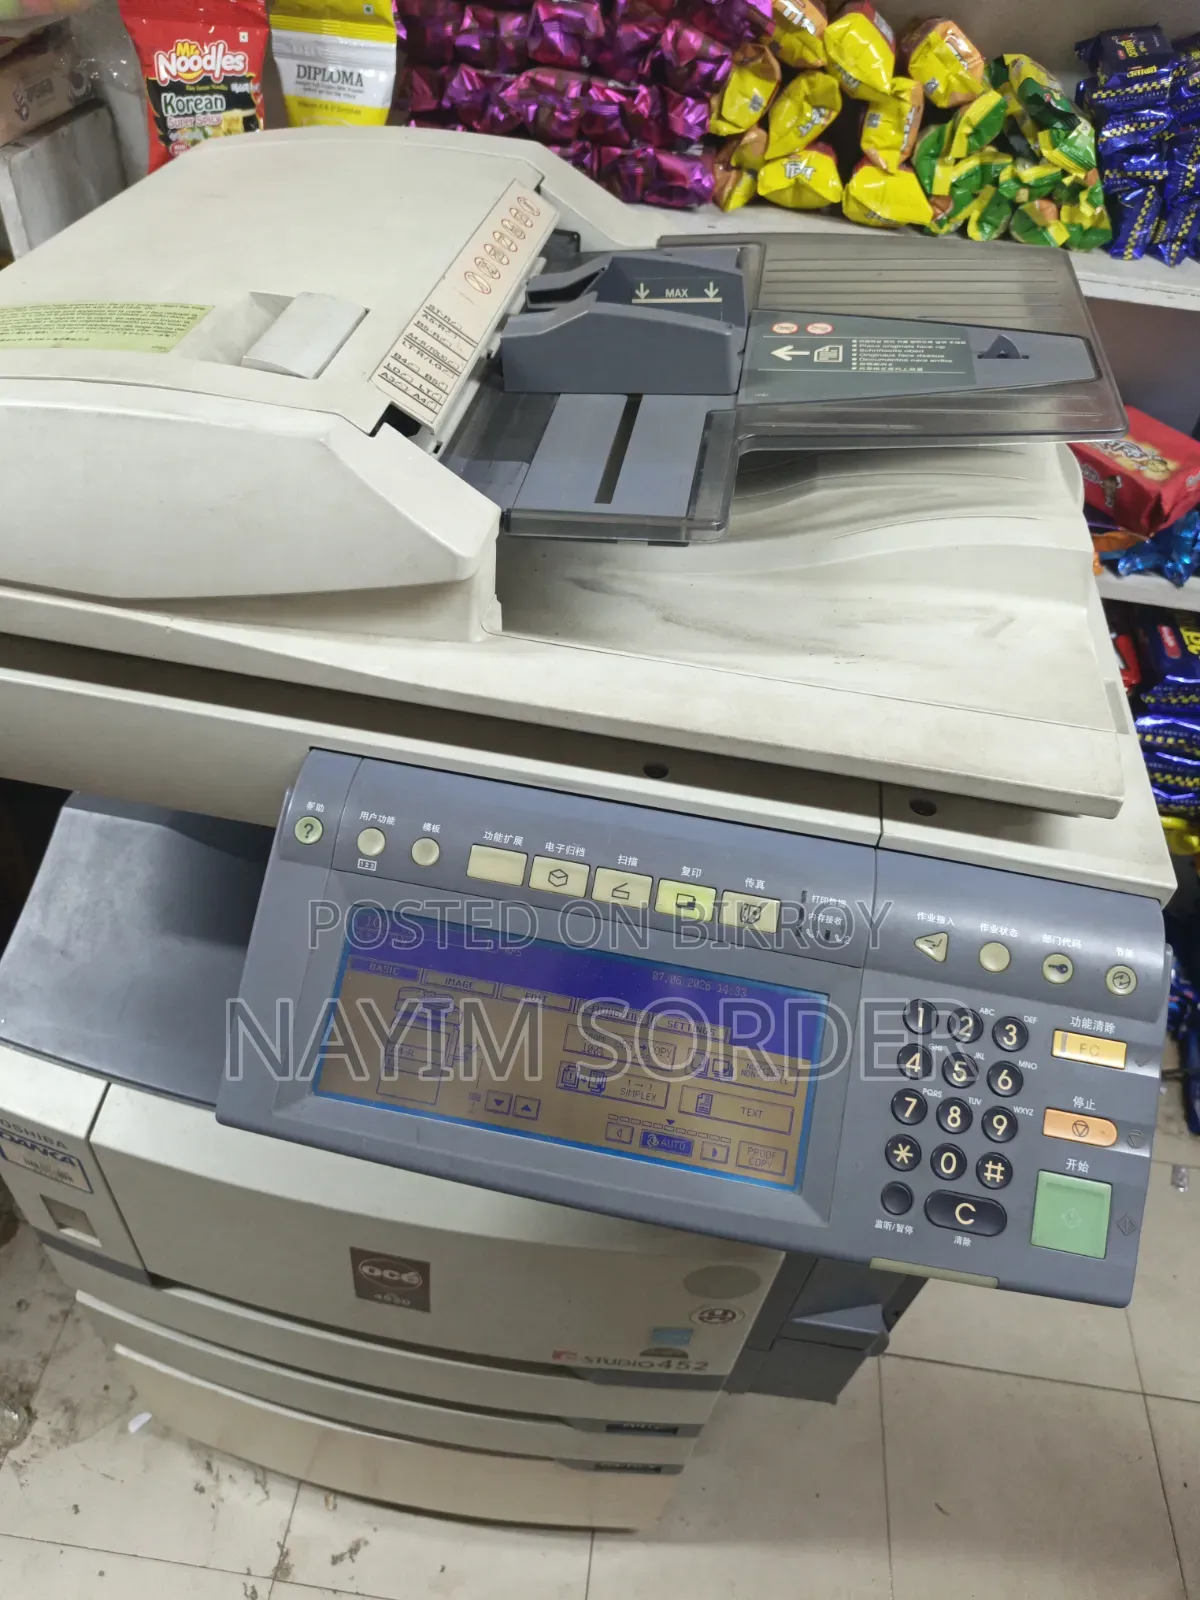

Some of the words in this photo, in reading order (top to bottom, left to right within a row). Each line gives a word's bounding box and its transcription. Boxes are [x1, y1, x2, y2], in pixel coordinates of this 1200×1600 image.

[176, 42, 200, 57] Mr.
[157, 43, 246, 82] Noodles
[296, 64, 364, 87] DIPLOMA
[162, 93, 224, 115] Korean
[167, 114, 194, 128] Super
[195, 113, 223, 127] Spicy
[665, 288, 688, 298] MAX
[394, 353, 407, 364] B4
[387, 363, 400, 374] LD
[381, 372, 395, 383] A3
[419, 384, 432, 395] LT
[413, 393, 426, 404] A4
[359, 811, 396, 826] 用户功能
[422, 822, 441, 834] 模板
[483, 830, 524, 846] 功能扩展
[544, 841, 586, 857] 电子归档
[617, 854, 639, 867] 扫描
[680, 865, 702, 878] 复印
[745, 877, 766, 890] 传真
[980, 922, 1020, 938] 作业状态
[1042, 934, 1082, 949] 部门代码
[369, 962, 400, 976] BASIC
[445, 977, 475, 989] IMAGE
[652, 971, 711, 991] 07.06.2026
[717, 984, 747, 998] 14:33
[525, 992, 548, 1003] EDIT
[917, 1007, 924, 1028] 1
[979, 1007, 995, 1016] ABC
[960, 1016, 974, 1037] 2
[1023, 1015, 1037, 1025] DEF
[1069, 1016, 1116, 1034] 功能清除
[667, 1020, 715, 1036] SETTINGS
[1003, 1024, 1017, 1045] 3
[974, 1052, 985, 1061] JKL
[1079, 1043, 1100, 1057] FC
[905, 1052, 921, 1072] 4
[1018, 1060, 1038, 1070] MNO
[952, 1060, 967, 1082] 5
[997, 1069, 1013, 1090] 6
[620, 1087, 657, 1103] SIMPLEX
[922, 1087, 942, 1098] PQRS
[904, 1097, 918, 1118] 7
[968, 1096, 982, 1106] TUV
[1072, 1096, 1096, 1111] 停止
[741, 1106, 763, 1119] TEXT
[947, 1106, 961, 1128] 8
[1013, 1105, 1034, 1116] WXYZ
[992, 1115, 1008, 1136] 9
[661, 1138, 686, 1150] AUTO
[747, 1147, 776, 1160] PROOF
[748, 1157, 773, 1170] COPY
[940, 1152, 957, 1174] 0
[1066, 1158, 1089, 1173] 开始
[983, 1160, 1005, 1182] #
[955, 1202, 976, 1225] C
[874, 1219, 914, 1235] 监听/暂停
[953, 1236, 972, 1247] 清除
